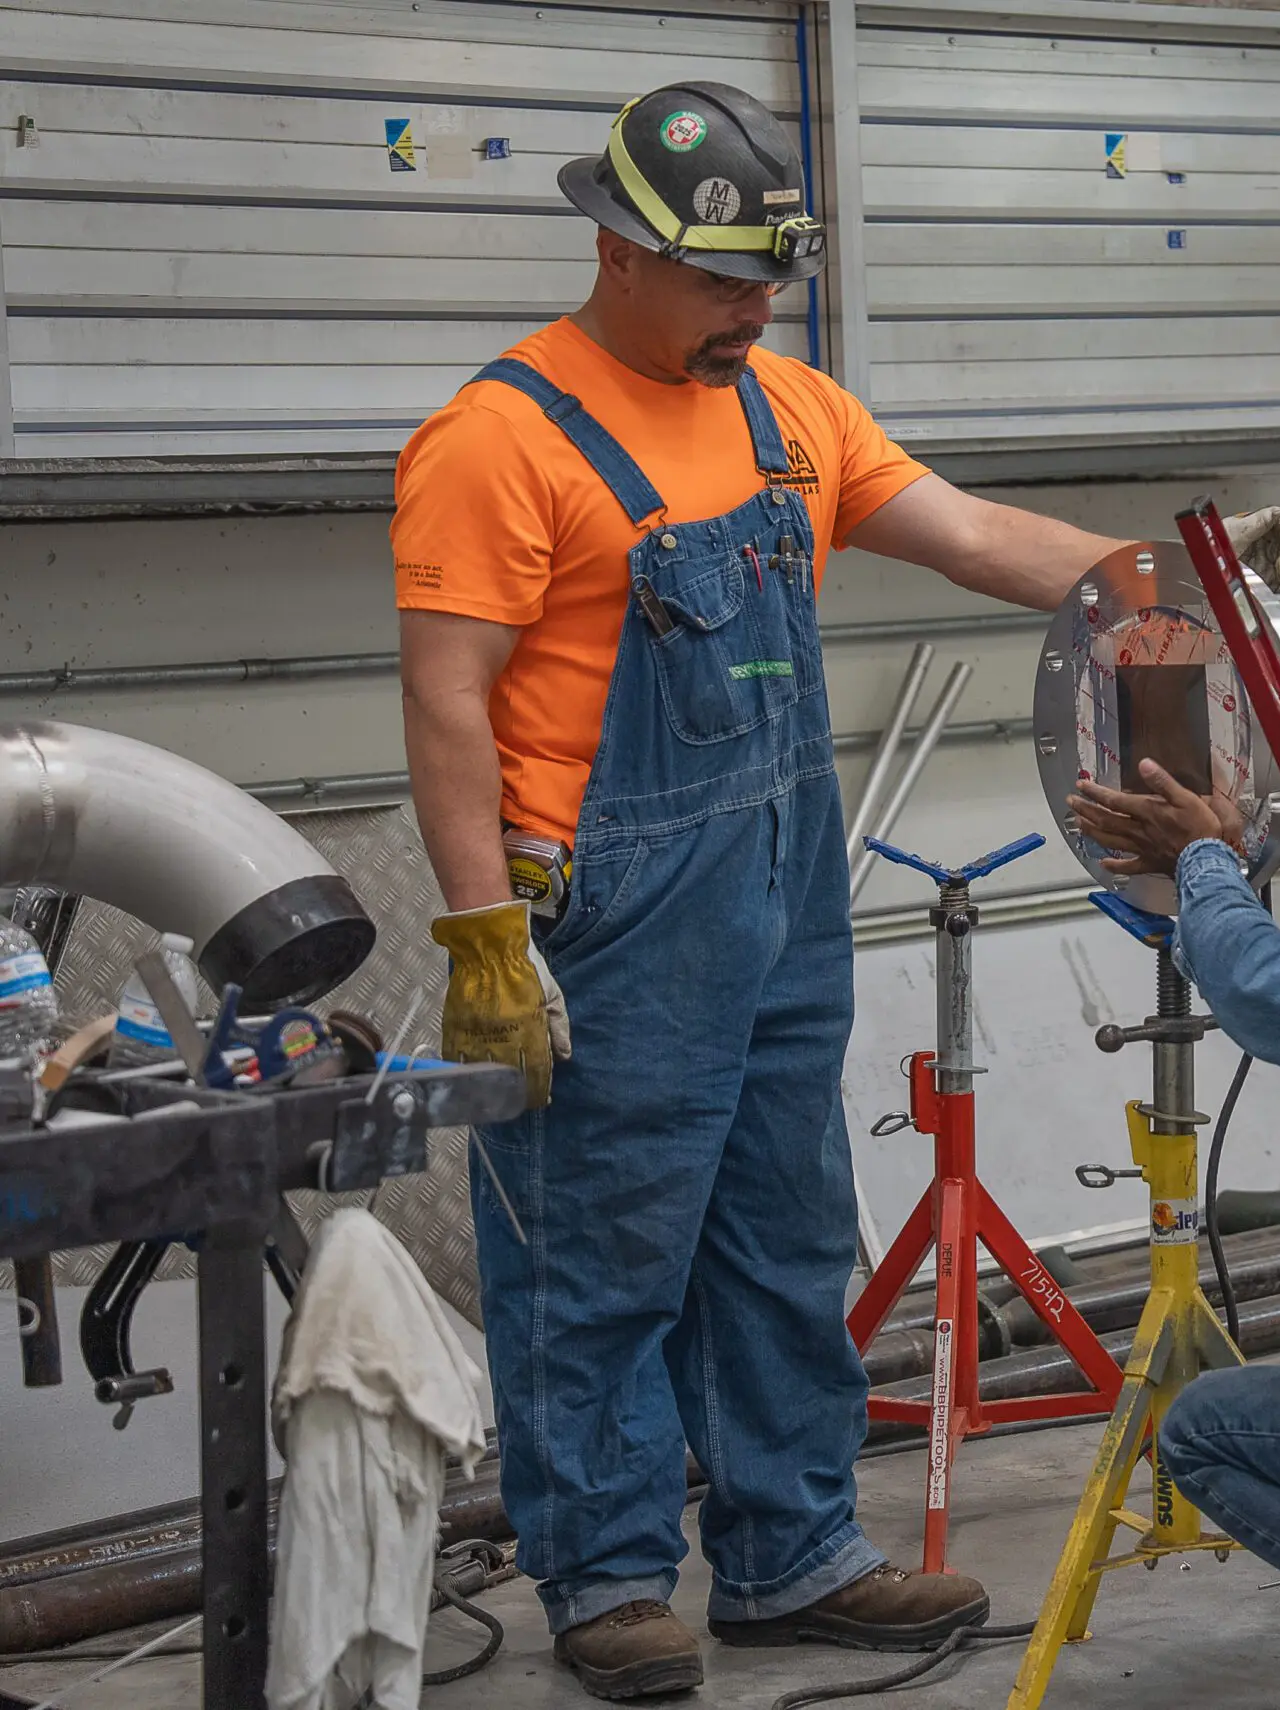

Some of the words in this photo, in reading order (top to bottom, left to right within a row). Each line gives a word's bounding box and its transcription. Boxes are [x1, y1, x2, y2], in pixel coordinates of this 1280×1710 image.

[674, 123, 692, 137] 2025
[710, 180, 730, 200] M
[1020, 1257, 1066, 1324] 71542
